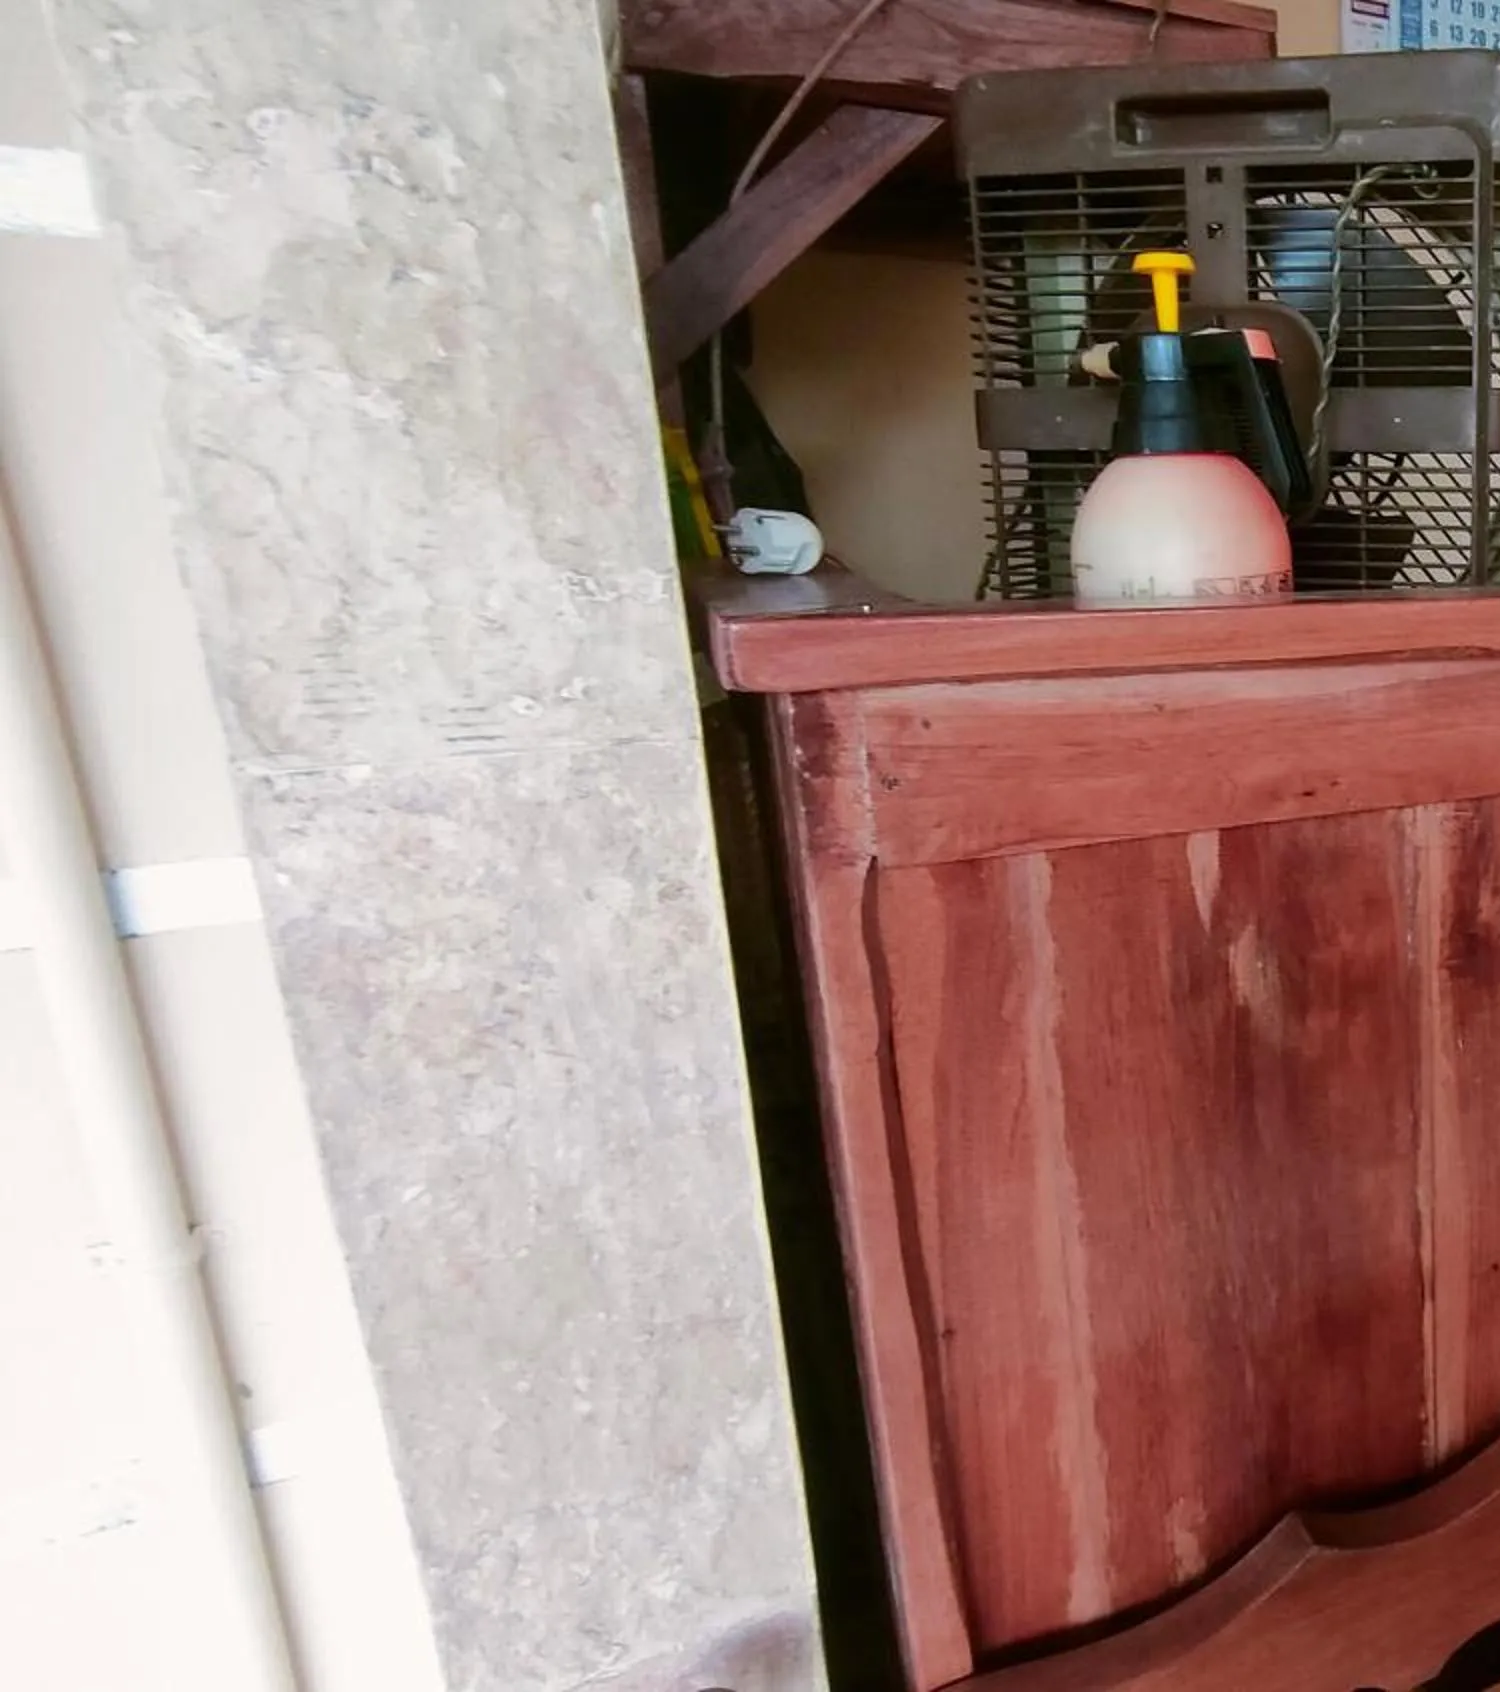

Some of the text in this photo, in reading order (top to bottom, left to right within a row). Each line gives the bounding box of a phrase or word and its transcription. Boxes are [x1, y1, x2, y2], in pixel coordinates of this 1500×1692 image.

[1451, 0, 1462, 14] 12
[1450, 24, 1463, 42] 13
[1470, 28, 1487, 47] 20
